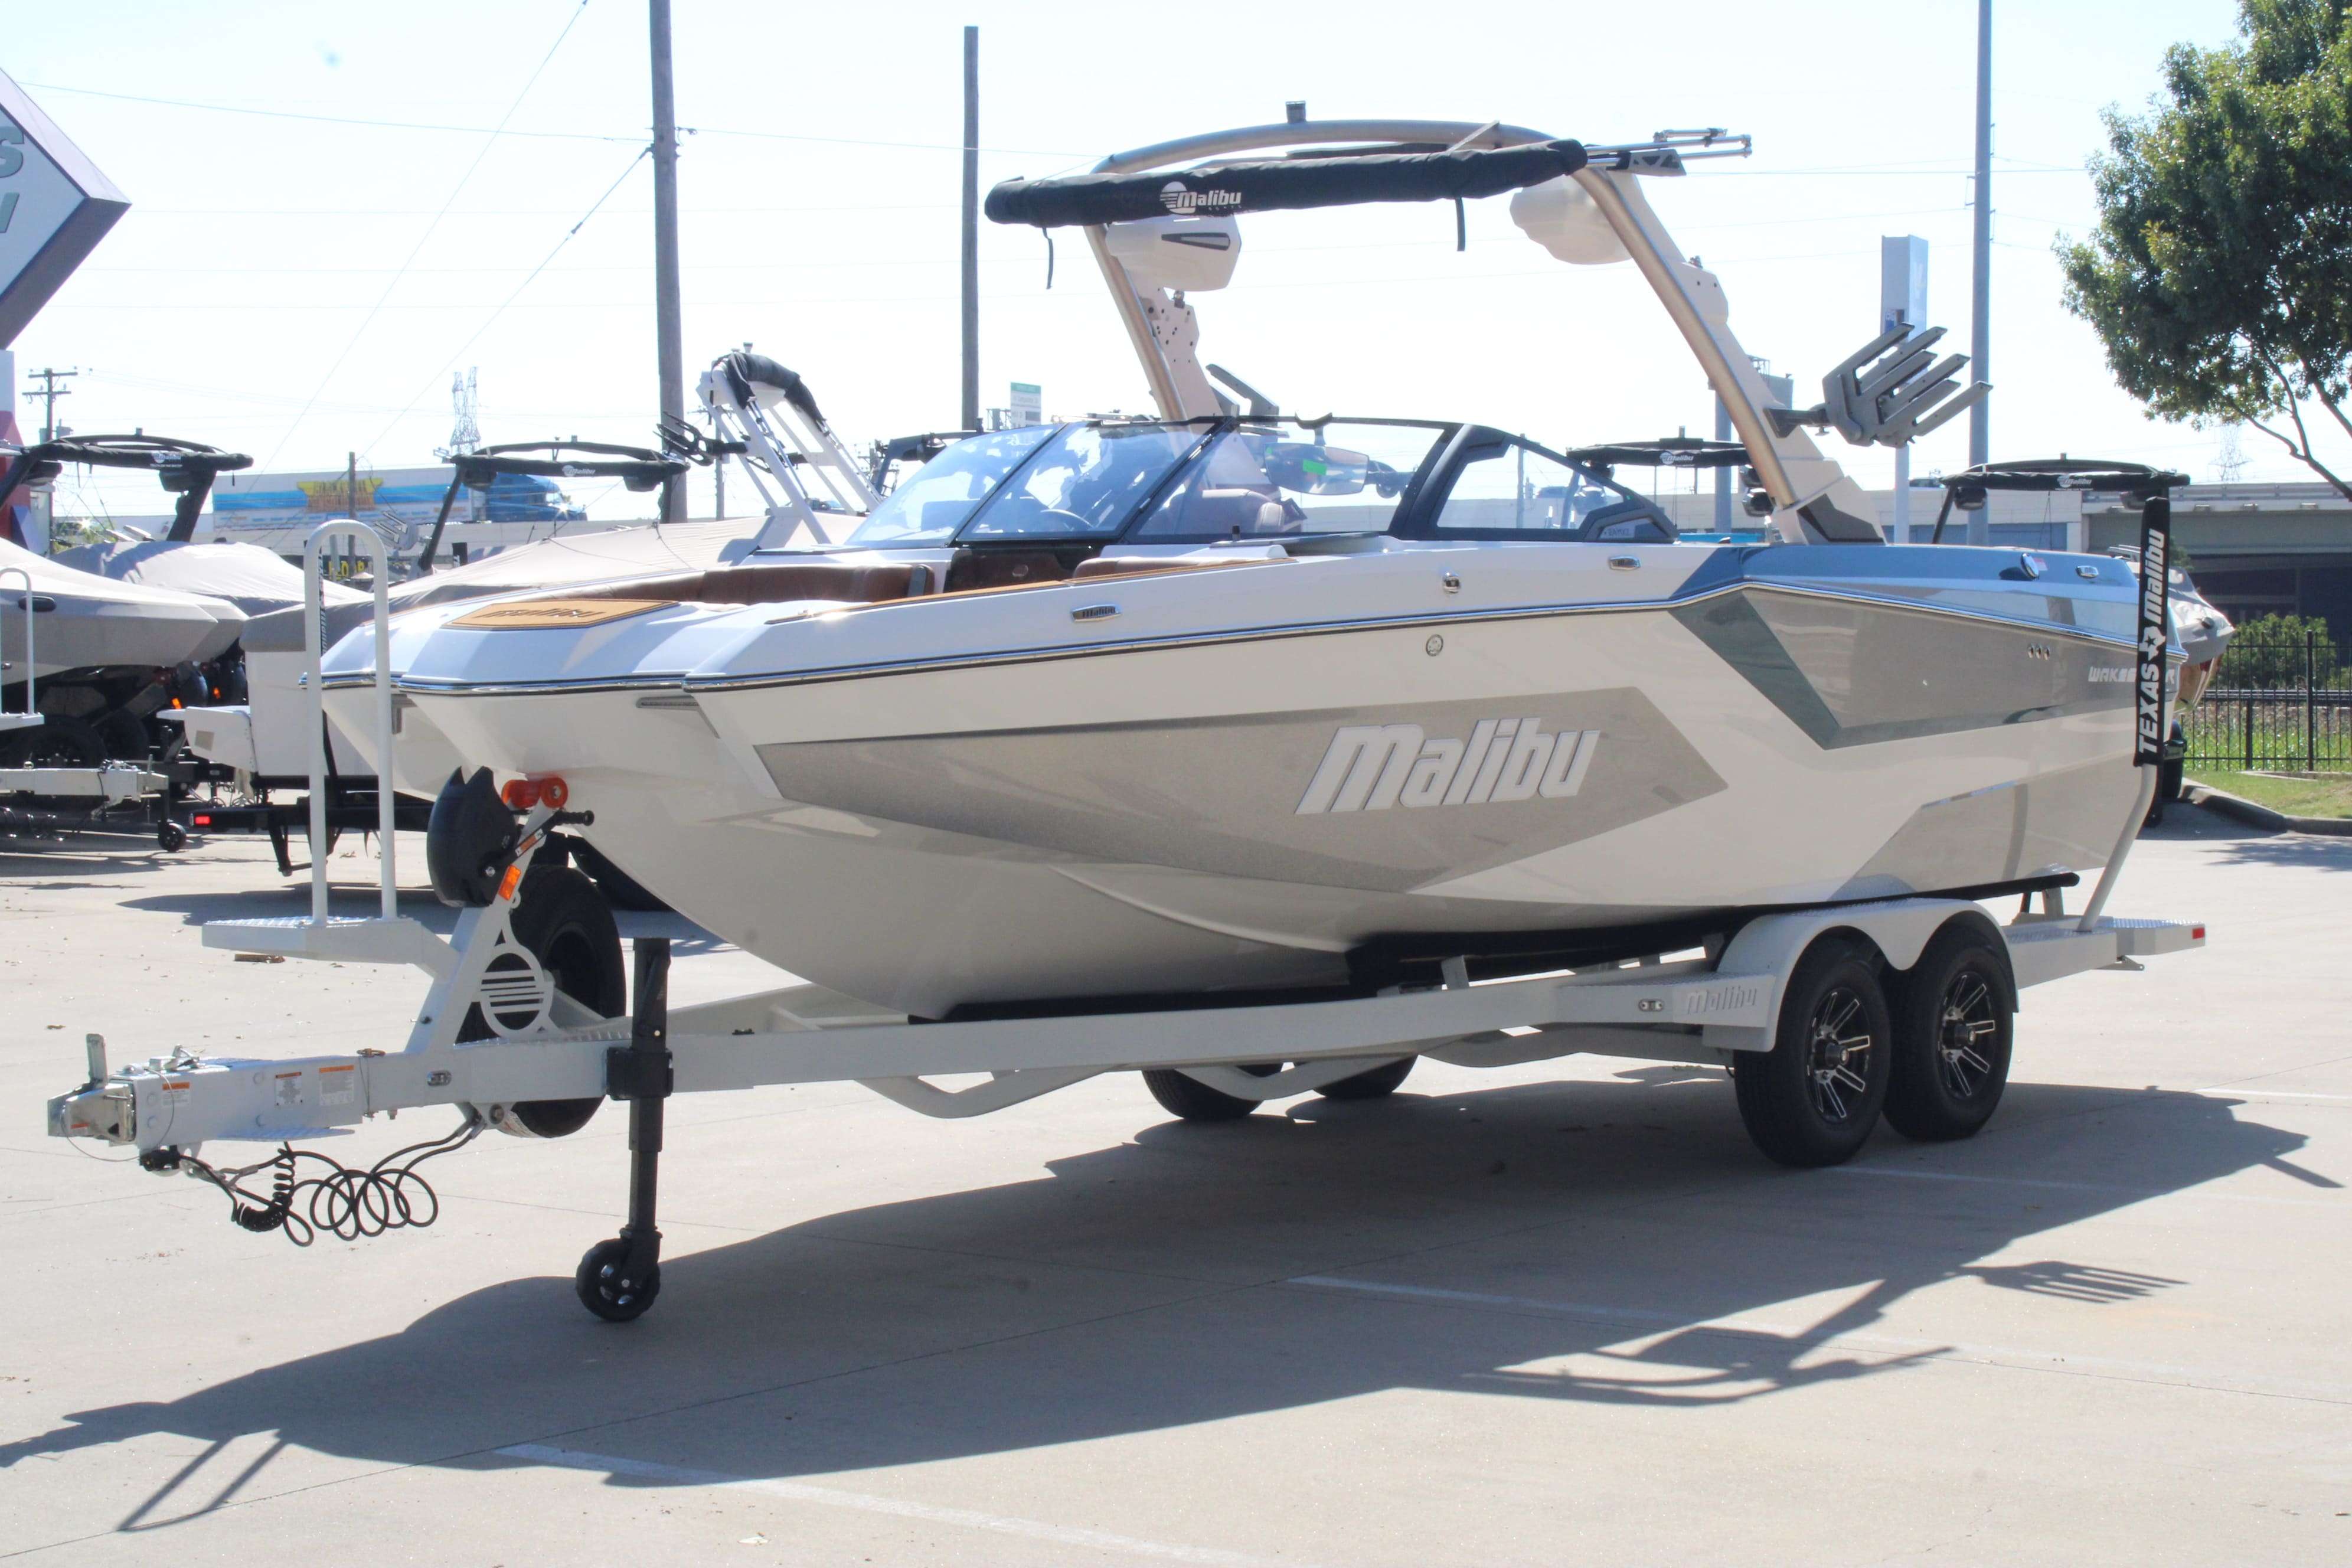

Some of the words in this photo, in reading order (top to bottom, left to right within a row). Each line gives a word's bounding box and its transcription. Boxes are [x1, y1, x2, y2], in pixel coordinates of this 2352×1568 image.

[1177, 190, 1242, 207] Malibu
[2144, 528, 2166, 625] Malibu
[2138, 662, 2160, 753] TEXAS
[1295, 717, 1600, 814] Malibu
[1687, 985, 1758, 1015] Malibu
